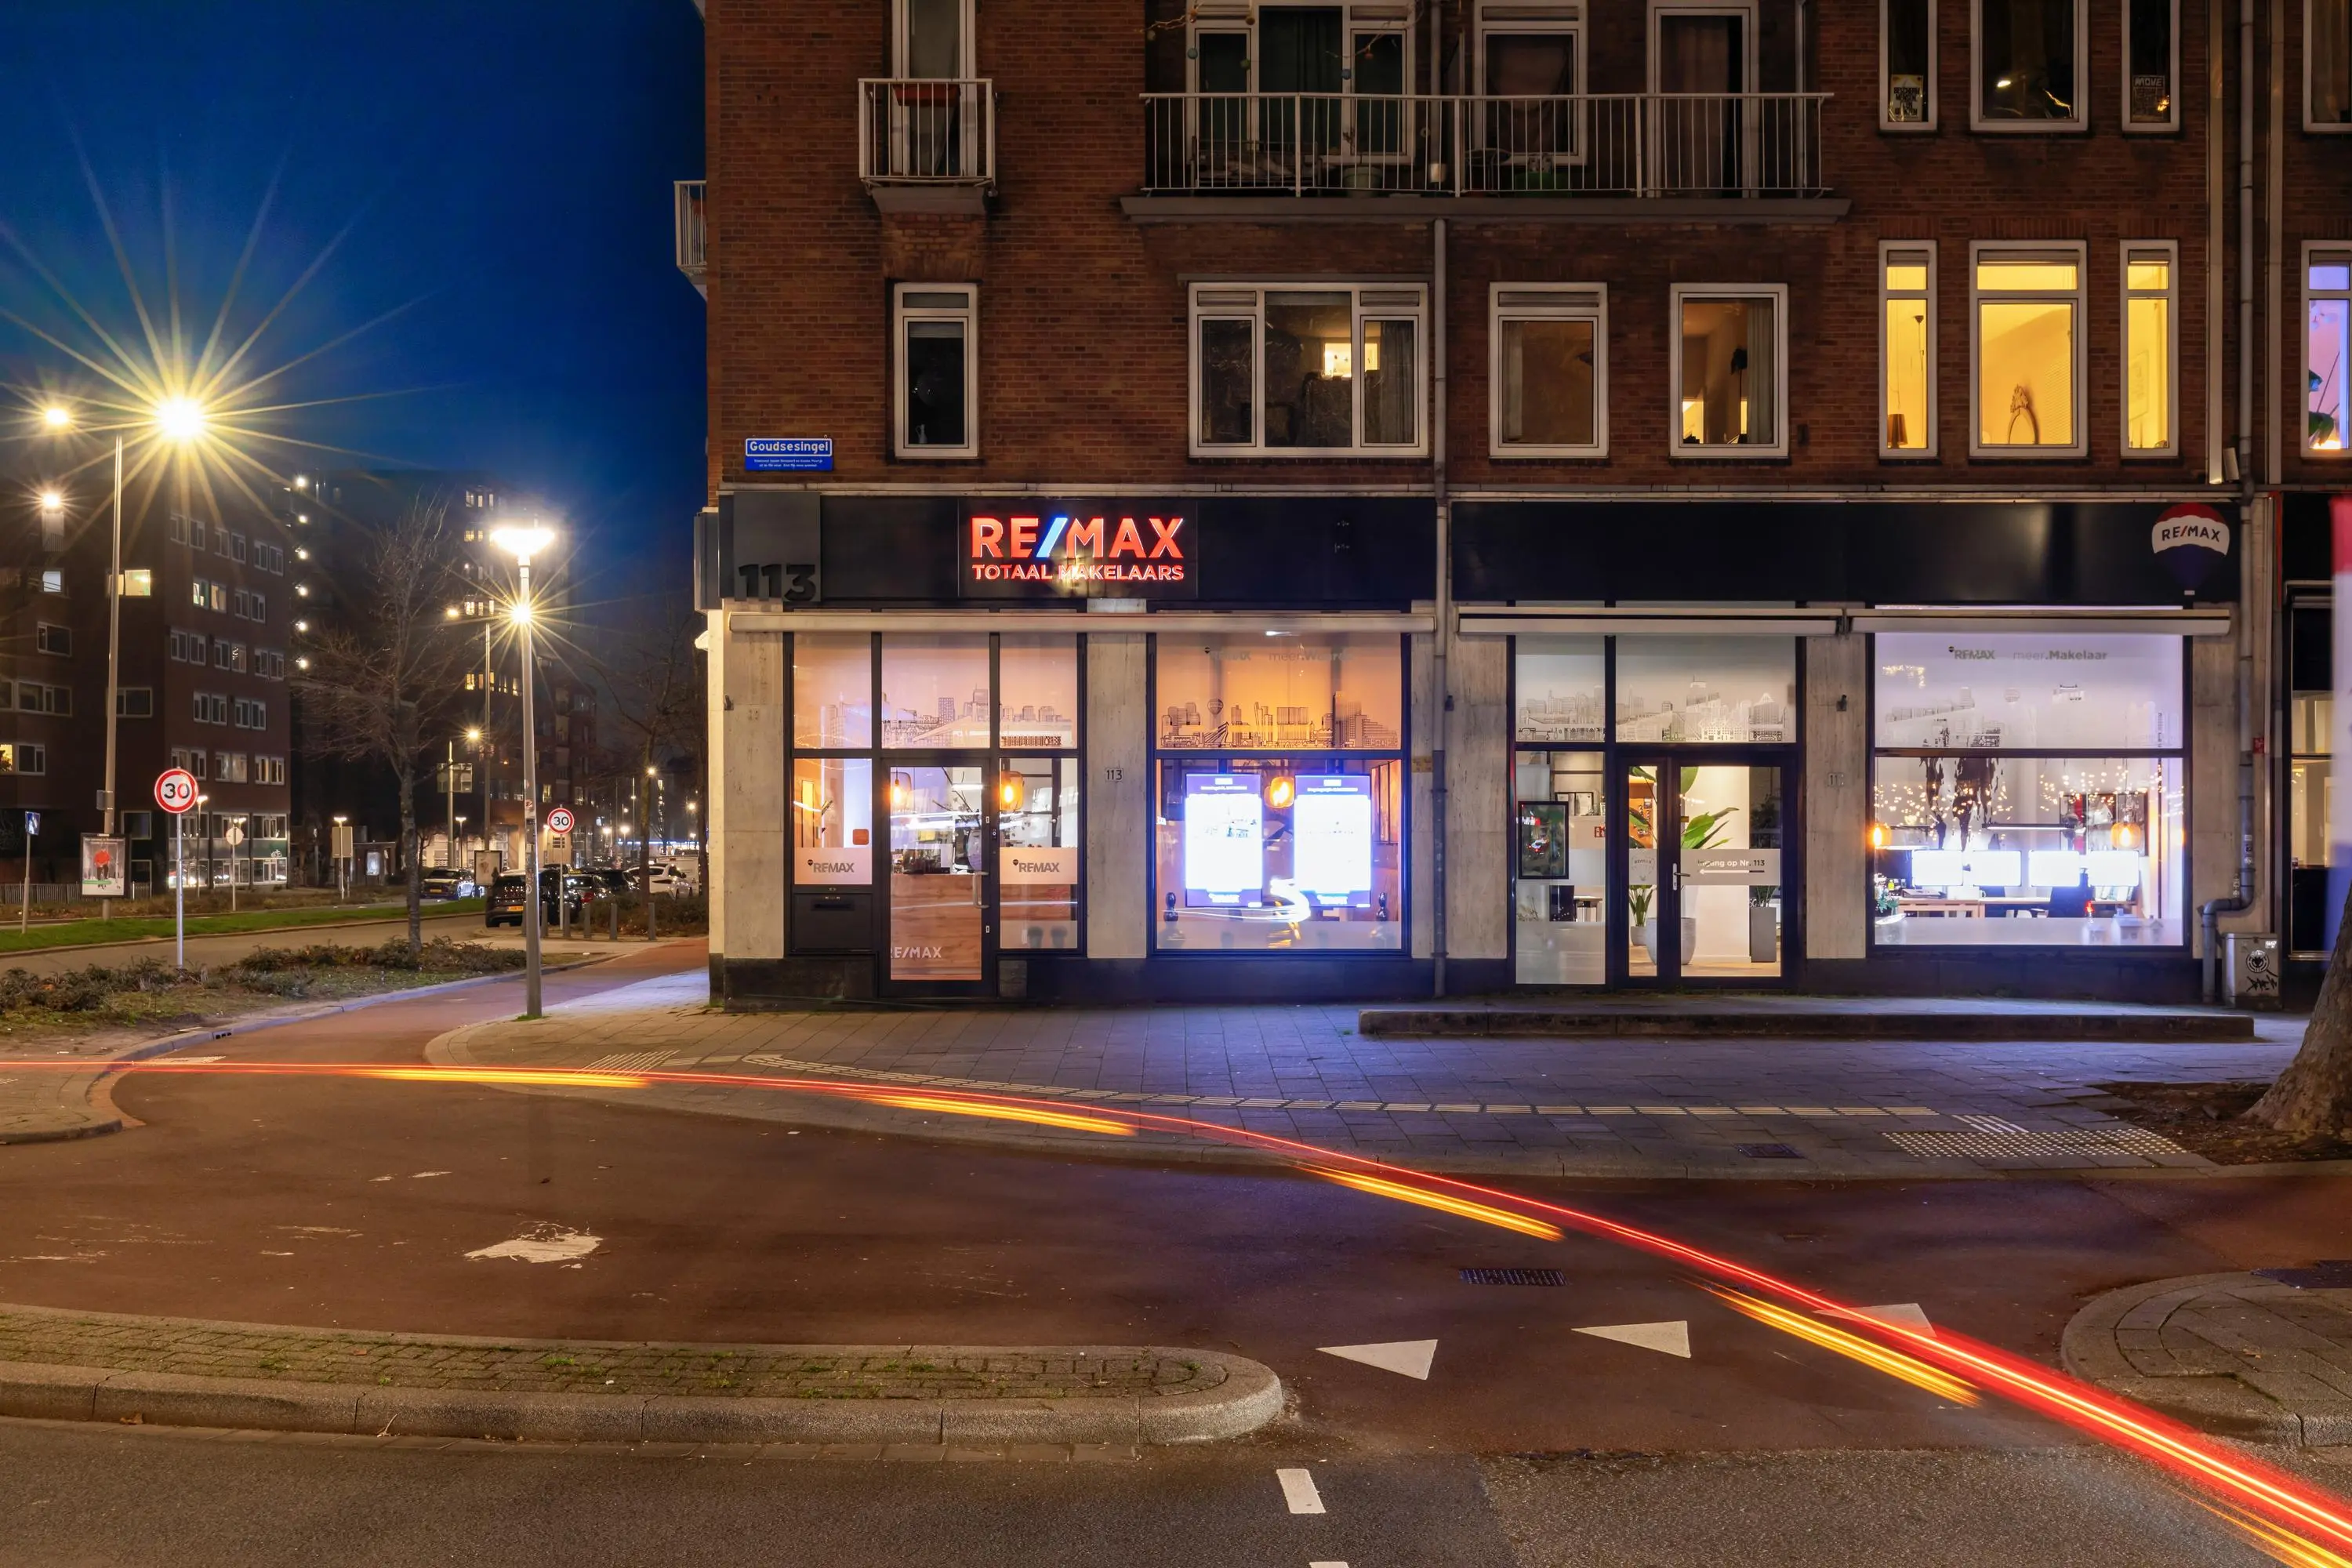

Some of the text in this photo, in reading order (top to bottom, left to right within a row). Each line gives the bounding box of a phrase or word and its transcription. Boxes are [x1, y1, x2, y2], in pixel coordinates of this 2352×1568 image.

[2134, 77, 2162, 86] MOVE
[749, 441, 829, 454] Goudsesingel
[971, 517, 1185, 558] RE/MAX
[2161, 524, 2220, 543] RE/MAX
[971, 564, 1185, 582] TOTAAL MAKELAARS
[738, 564, 816, 601] 113
[1106, 769, 1123, 781] 113
[164, 782, 191, 799] 30
[554, 816, 569, 826] 30
